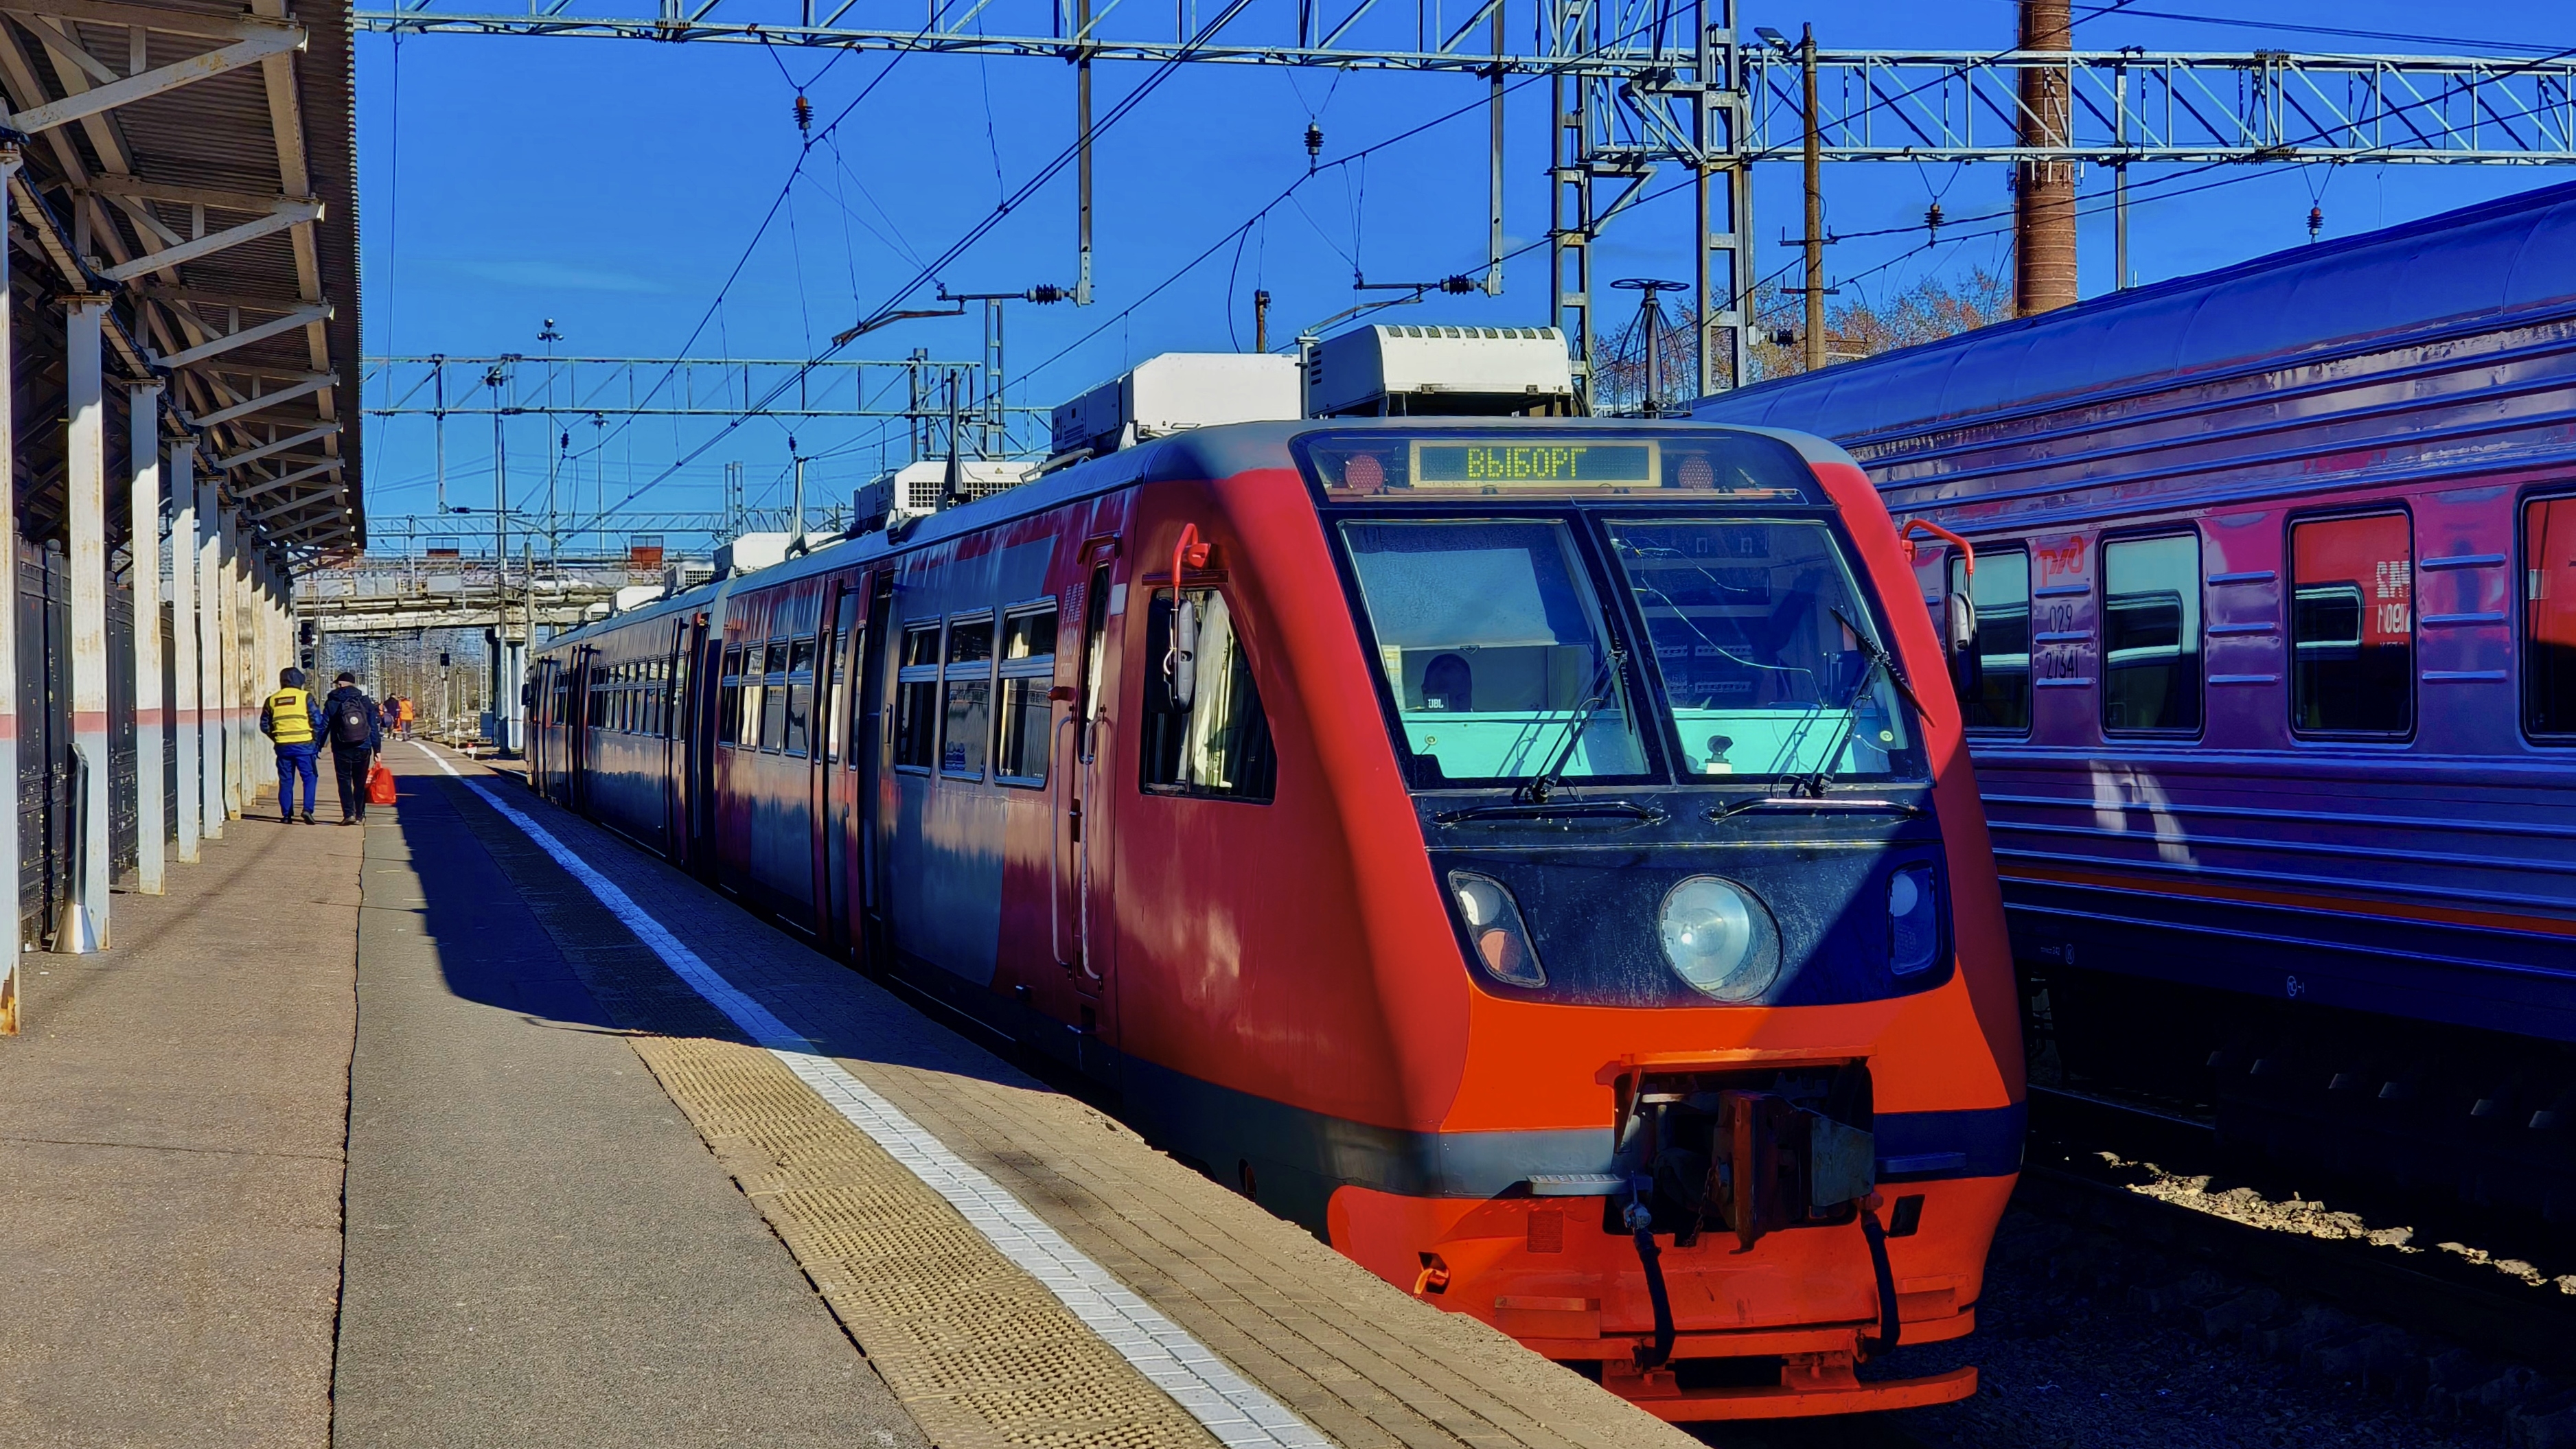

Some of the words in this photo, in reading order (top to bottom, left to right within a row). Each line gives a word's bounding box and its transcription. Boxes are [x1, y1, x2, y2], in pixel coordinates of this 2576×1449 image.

[1467, 447, 1587, 478] ВЫБОРГ
[2049, 605, 2073, 633] 029
[2045, 649, 2079, 680] 27341
[1427, 698, 1444, 709] JBL
